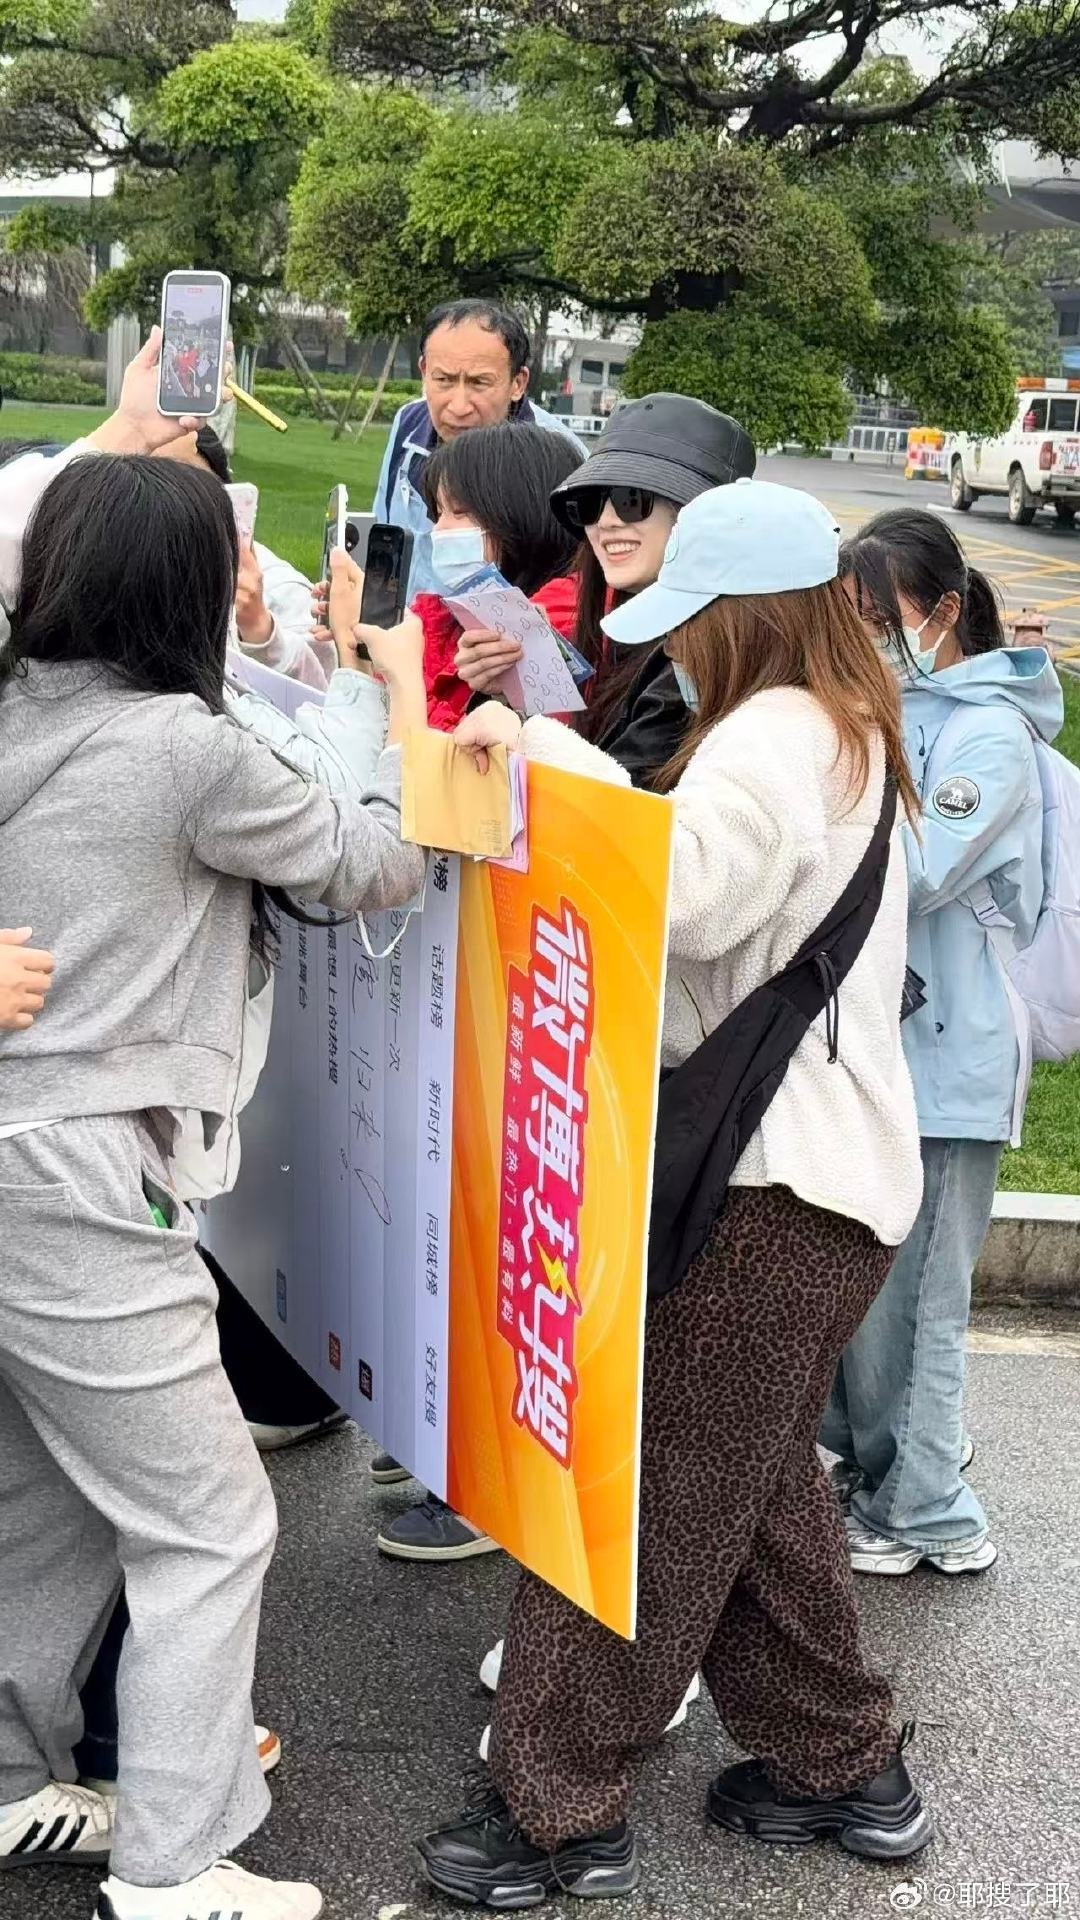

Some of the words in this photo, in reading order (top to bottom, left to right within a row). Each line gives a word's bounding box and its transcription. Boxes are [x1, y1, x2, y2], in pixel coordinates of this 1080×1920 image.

[940, 796, 967, 810] CAMEL
[430, 944, 445, 1029] 话题榜
[428, 1079, 442, 1163] 新时代
[517, 906, 589, 1459] 微博热搜
[425, 1212, 439, 1297] 同城榜
[424, 1342, 439, 1428] 好友搜
